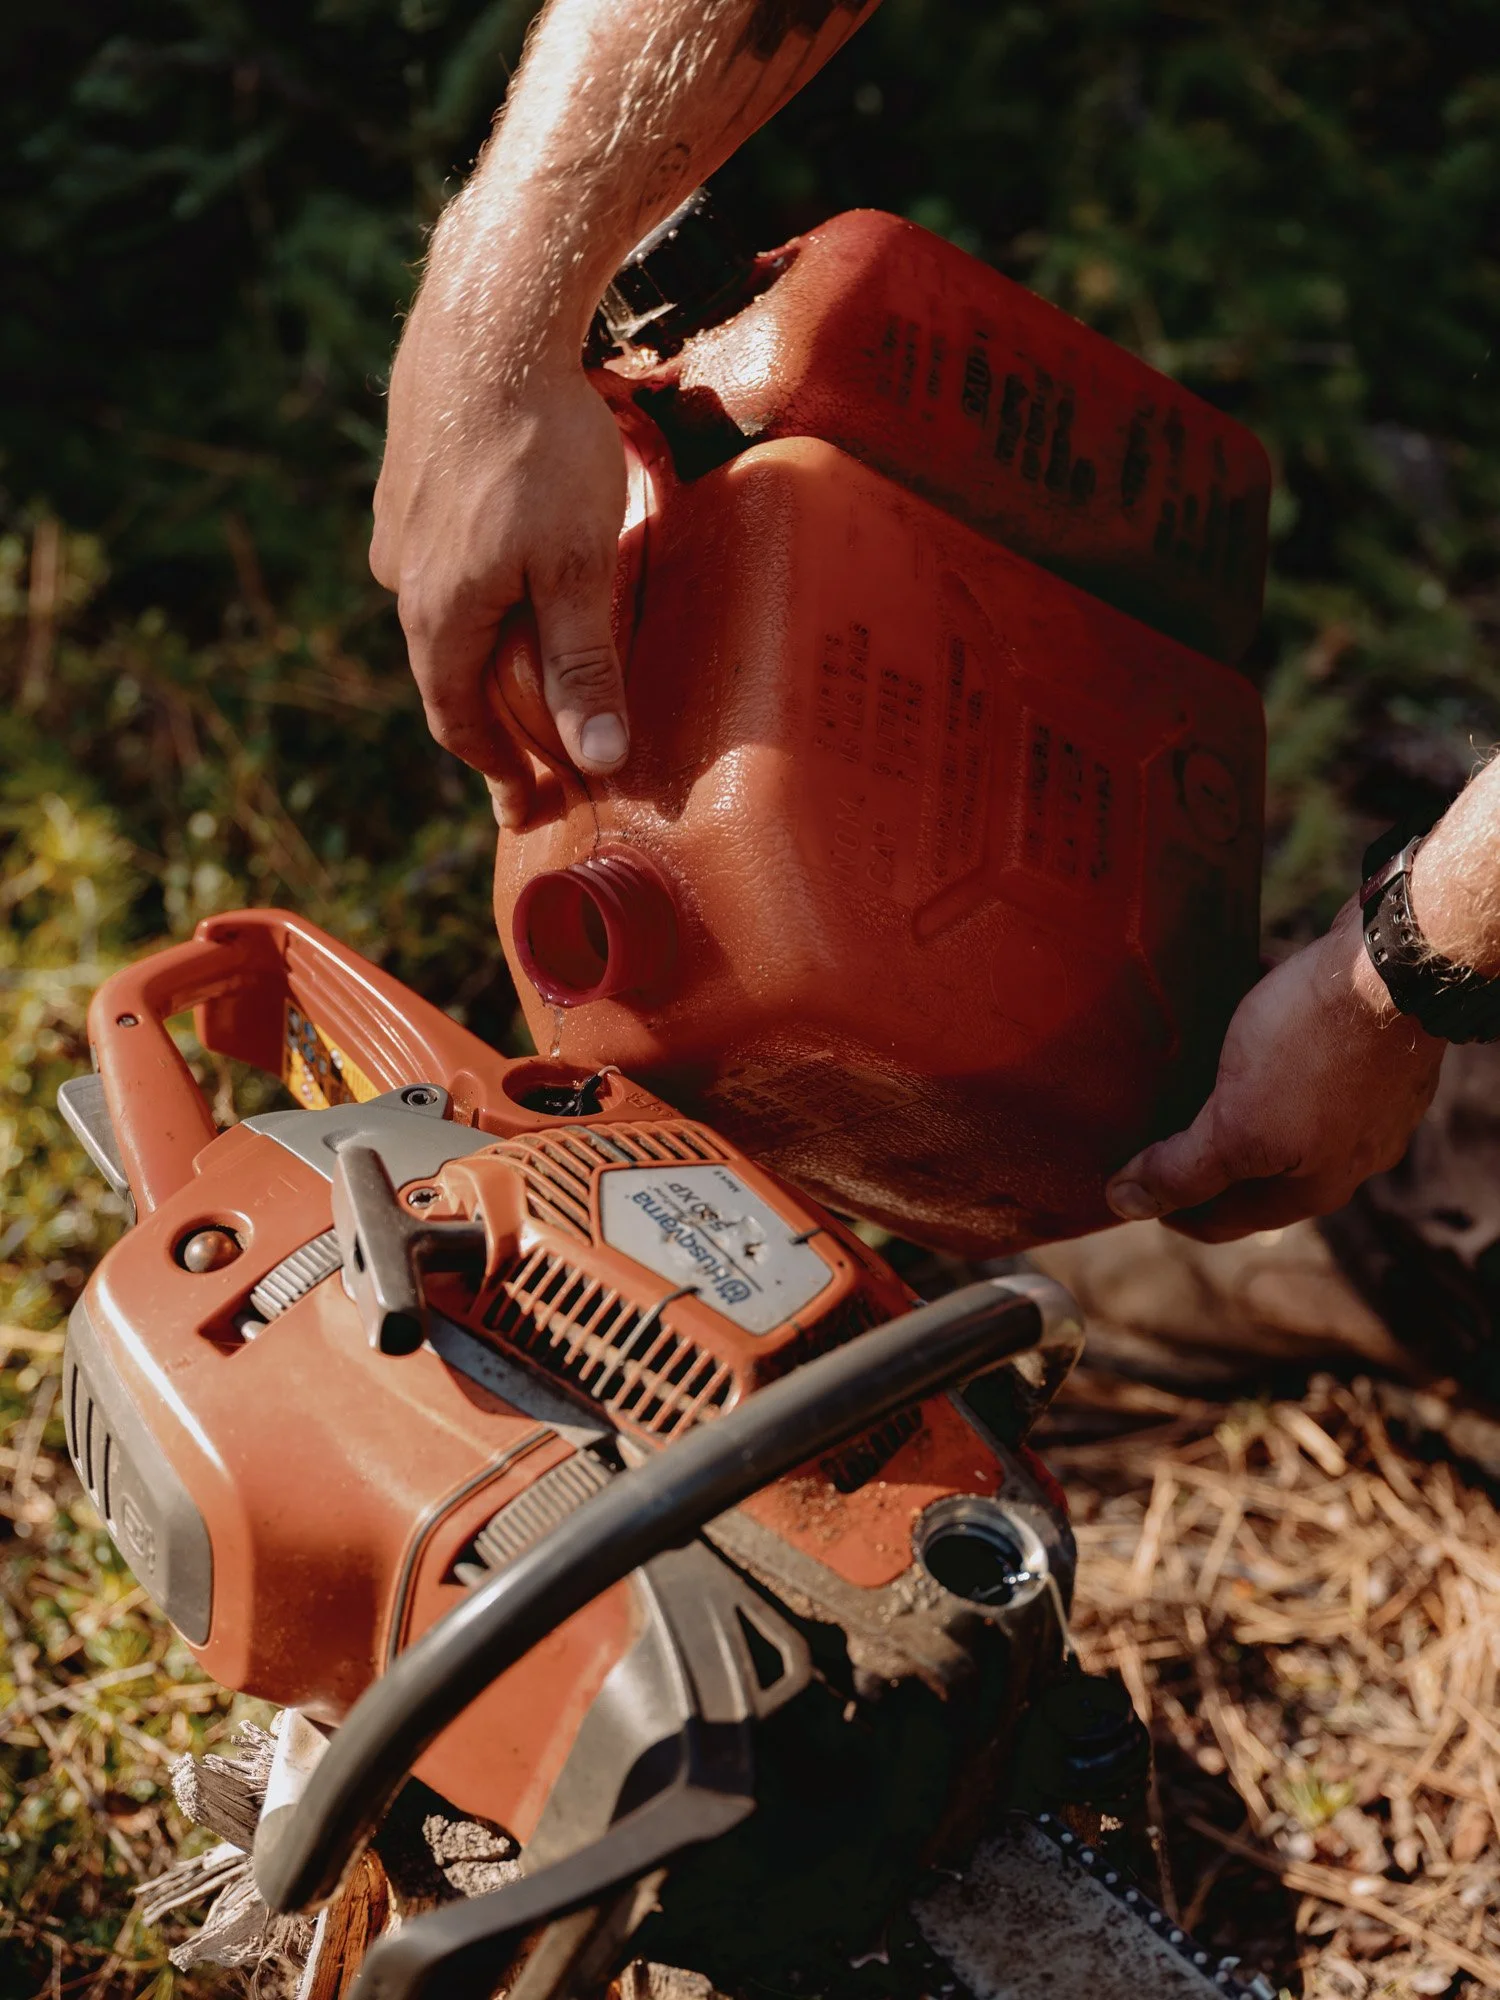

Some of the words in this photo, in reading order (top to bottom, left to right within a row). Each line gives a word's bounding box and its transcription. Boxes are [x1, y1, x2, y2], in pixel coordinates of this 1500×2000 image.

[874, 667, 901, 756] LITRES
[632, 1191, 730, 1283] Husqvarna
[669, 1182, 700, 1203] XP
